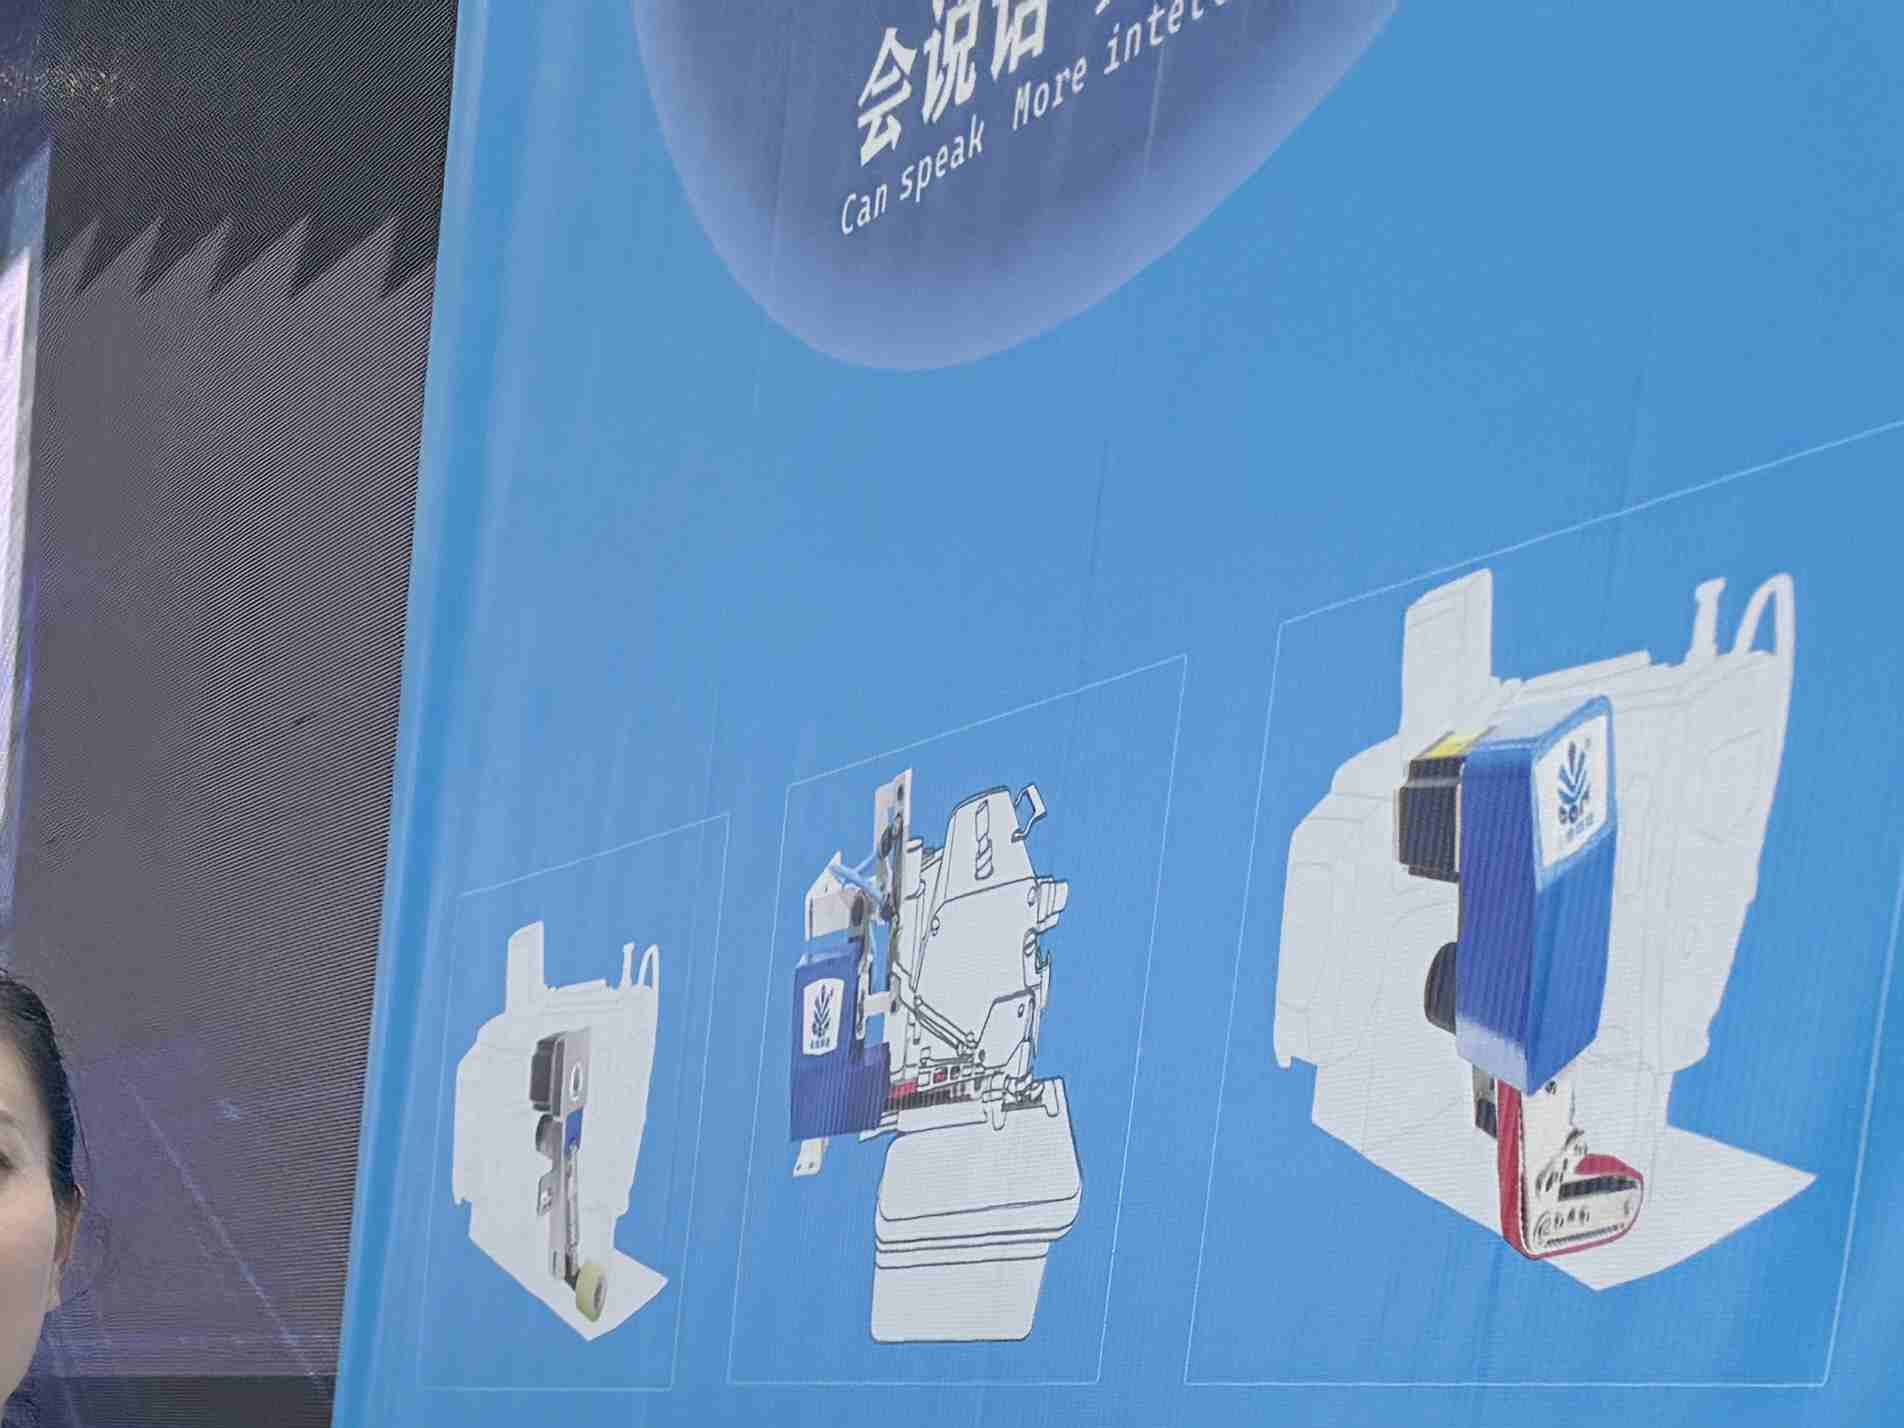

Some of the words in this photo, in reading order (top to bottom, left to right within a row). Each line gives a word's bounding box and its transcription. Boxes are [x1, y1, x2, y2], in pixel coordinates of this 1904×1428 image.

[841, 180, 887, 236] Can
[899, 119, 985, 203] speak
[1012, 56, 1088, 131] More
